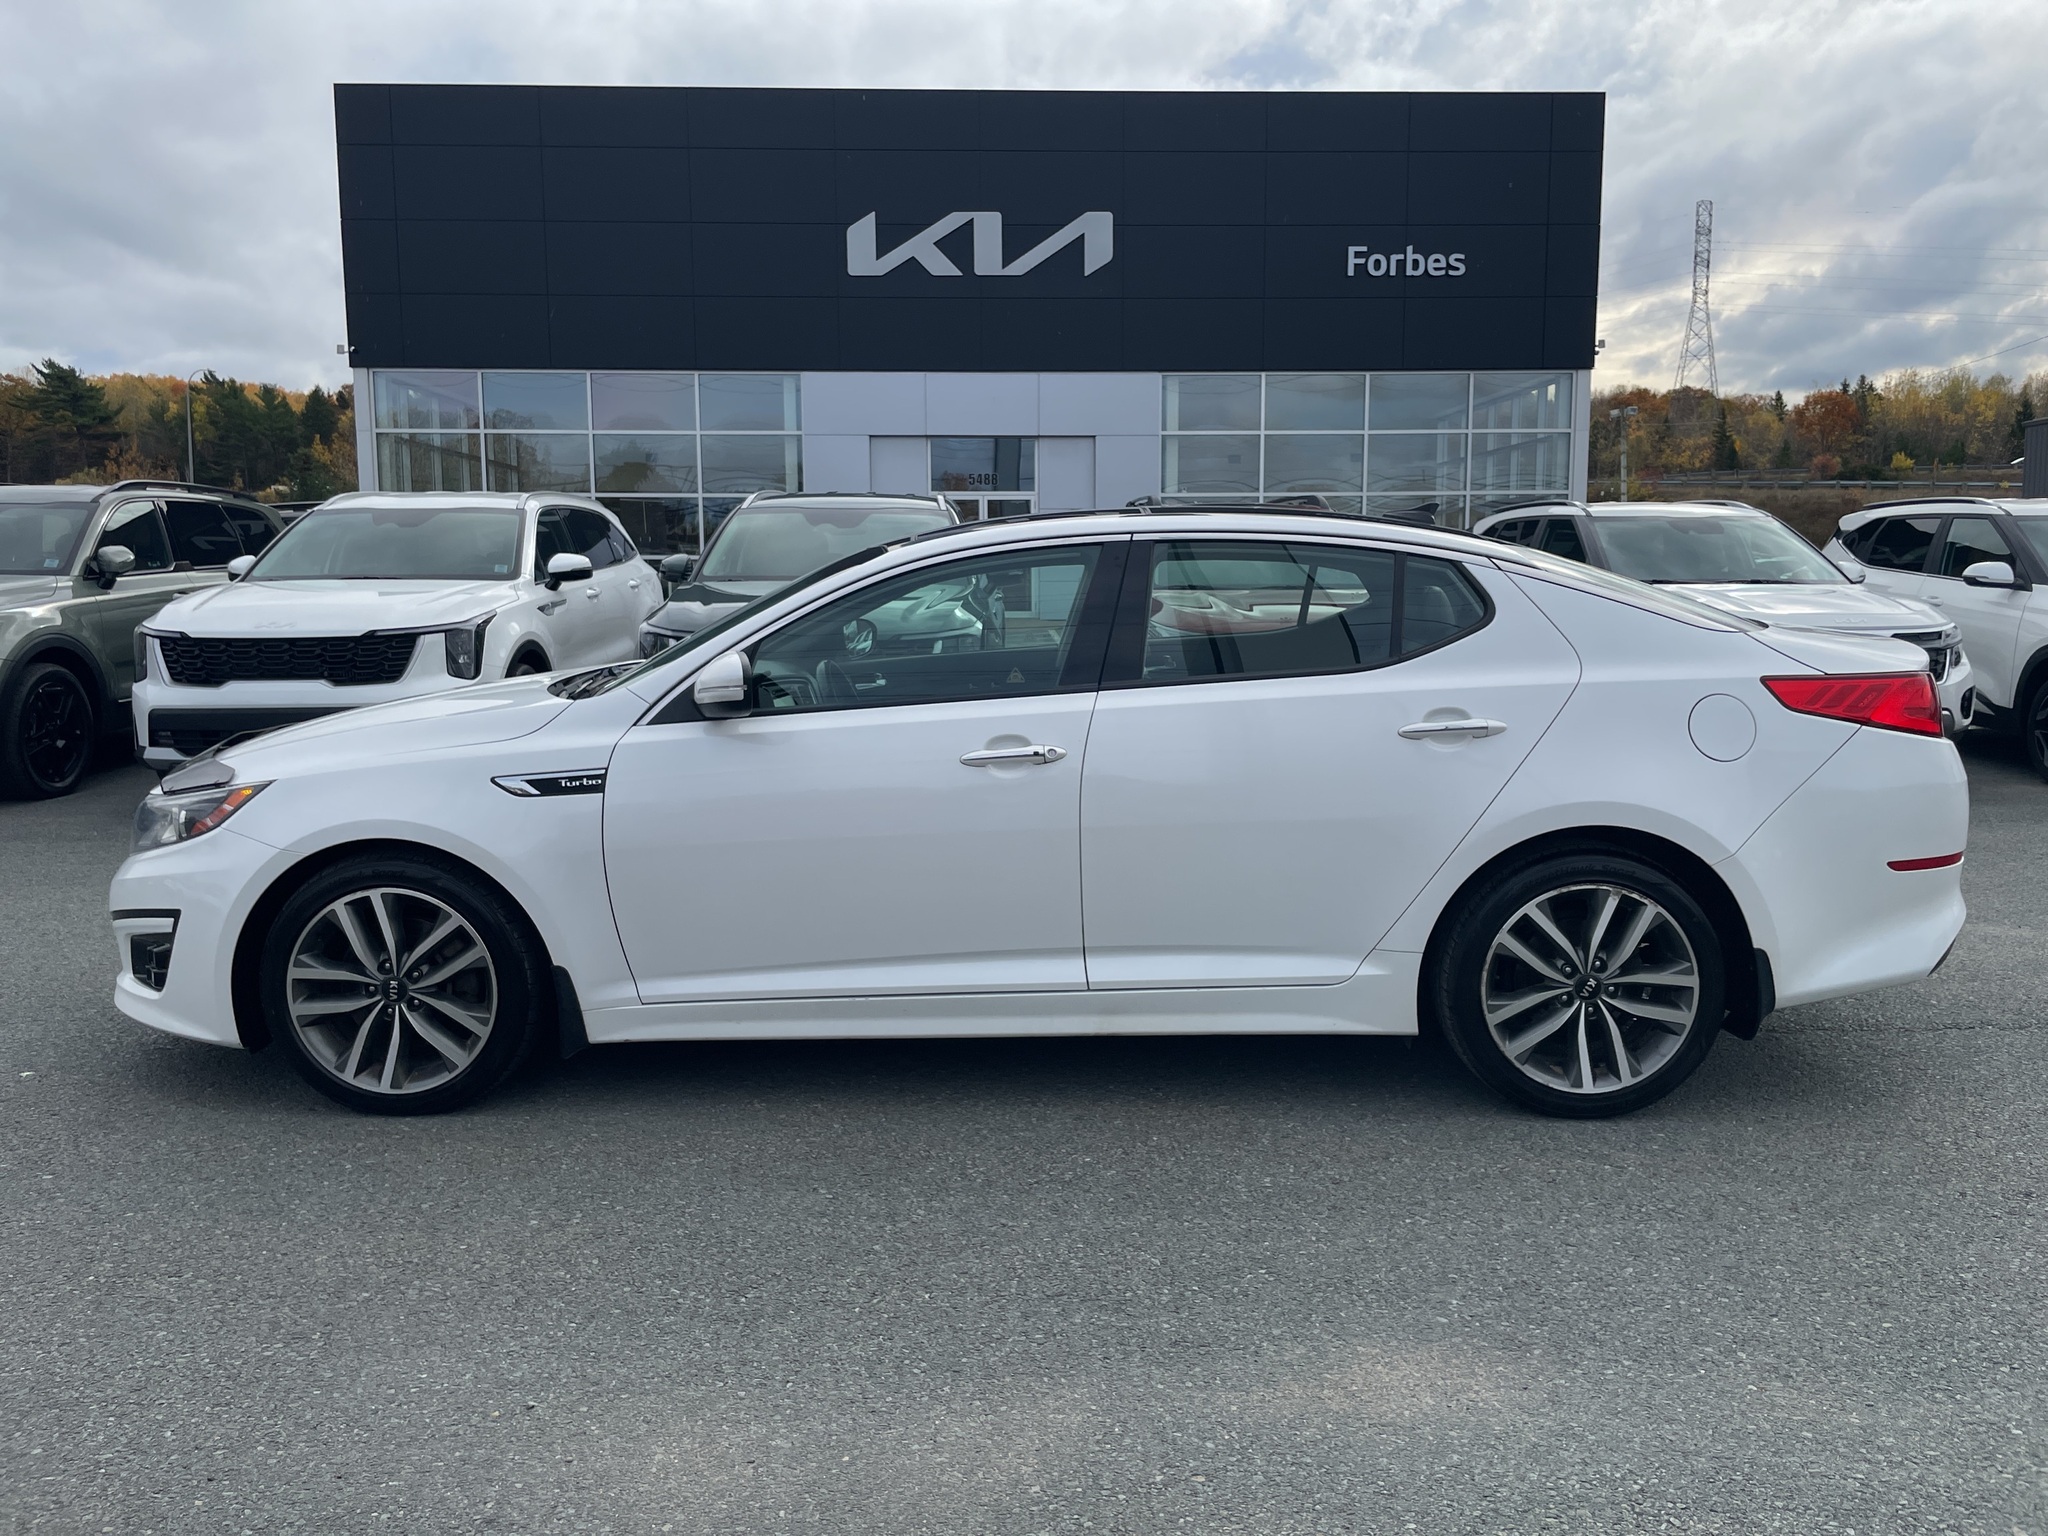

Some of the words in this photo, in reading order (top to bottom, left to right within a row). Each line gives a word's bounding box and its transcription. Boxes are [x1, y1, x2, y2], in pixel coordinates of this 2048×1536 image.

[846, 211, 1114, 277] KIA
[1346, 245, 1467, 277] Forbes
[968, 473, 998, 486] 5488
[558, 778, 602, 787] Turbo
[389, 980, 399, 1000] KIA
[1579, 978, 1598, 997] KIA
